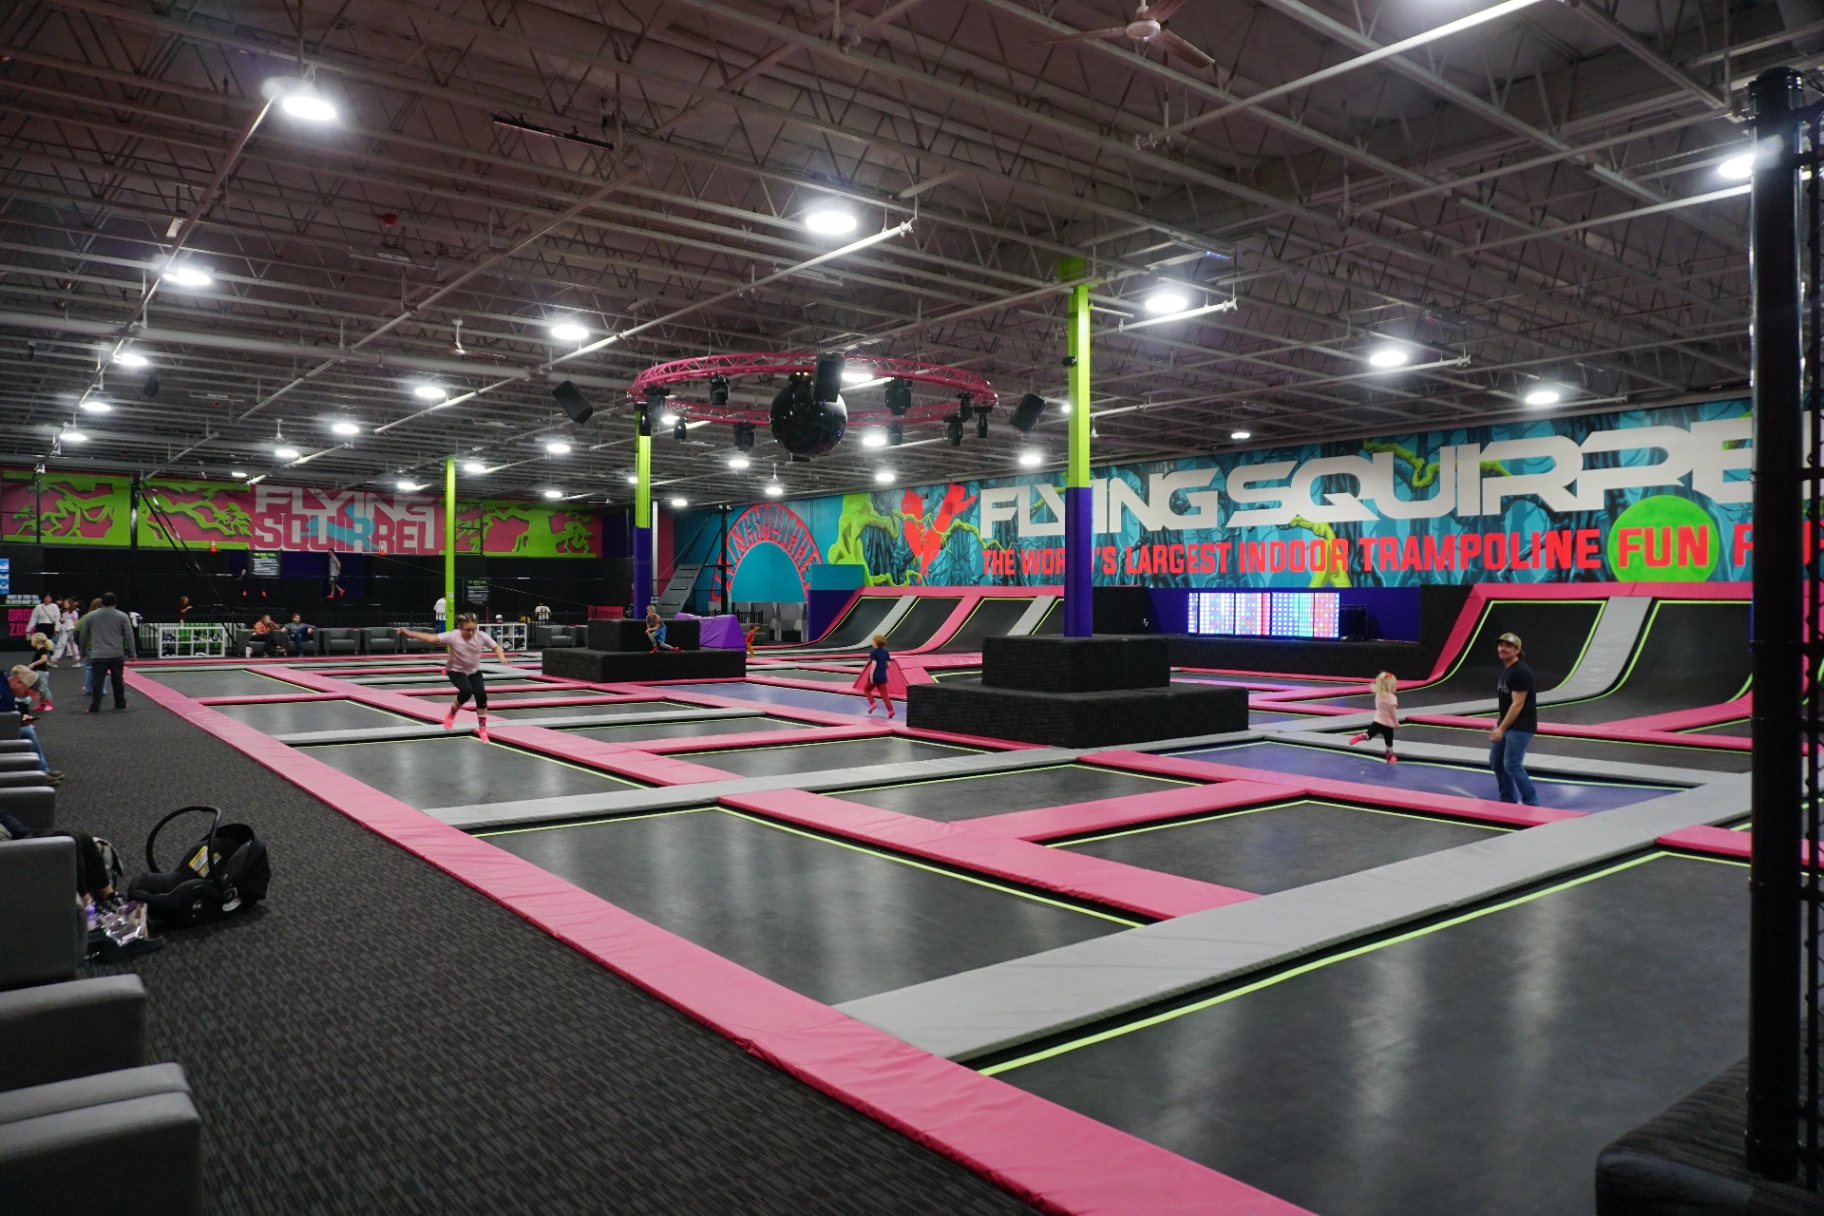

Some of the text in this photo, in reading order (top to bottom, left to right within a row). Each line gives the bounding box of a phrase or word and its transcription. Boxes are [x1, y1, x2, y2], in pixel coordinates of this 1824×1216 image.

[1226, 410, 1824, 528] SQUIRRE
[254, 512, 436, 556] SQUIRREL
[255, 485, 435, 549] FLYING
[982, 548, 1016, 575] THE
[1021, 545, 1117, 576] WOR'S
[1126, 541, 1231, 575] LARGEST
[1238, 537, 1349, 573] INDOOR
[1361, 528, 1602, 572] TRAMPOLINE
[1618, 524, 1710, 569] FUN
